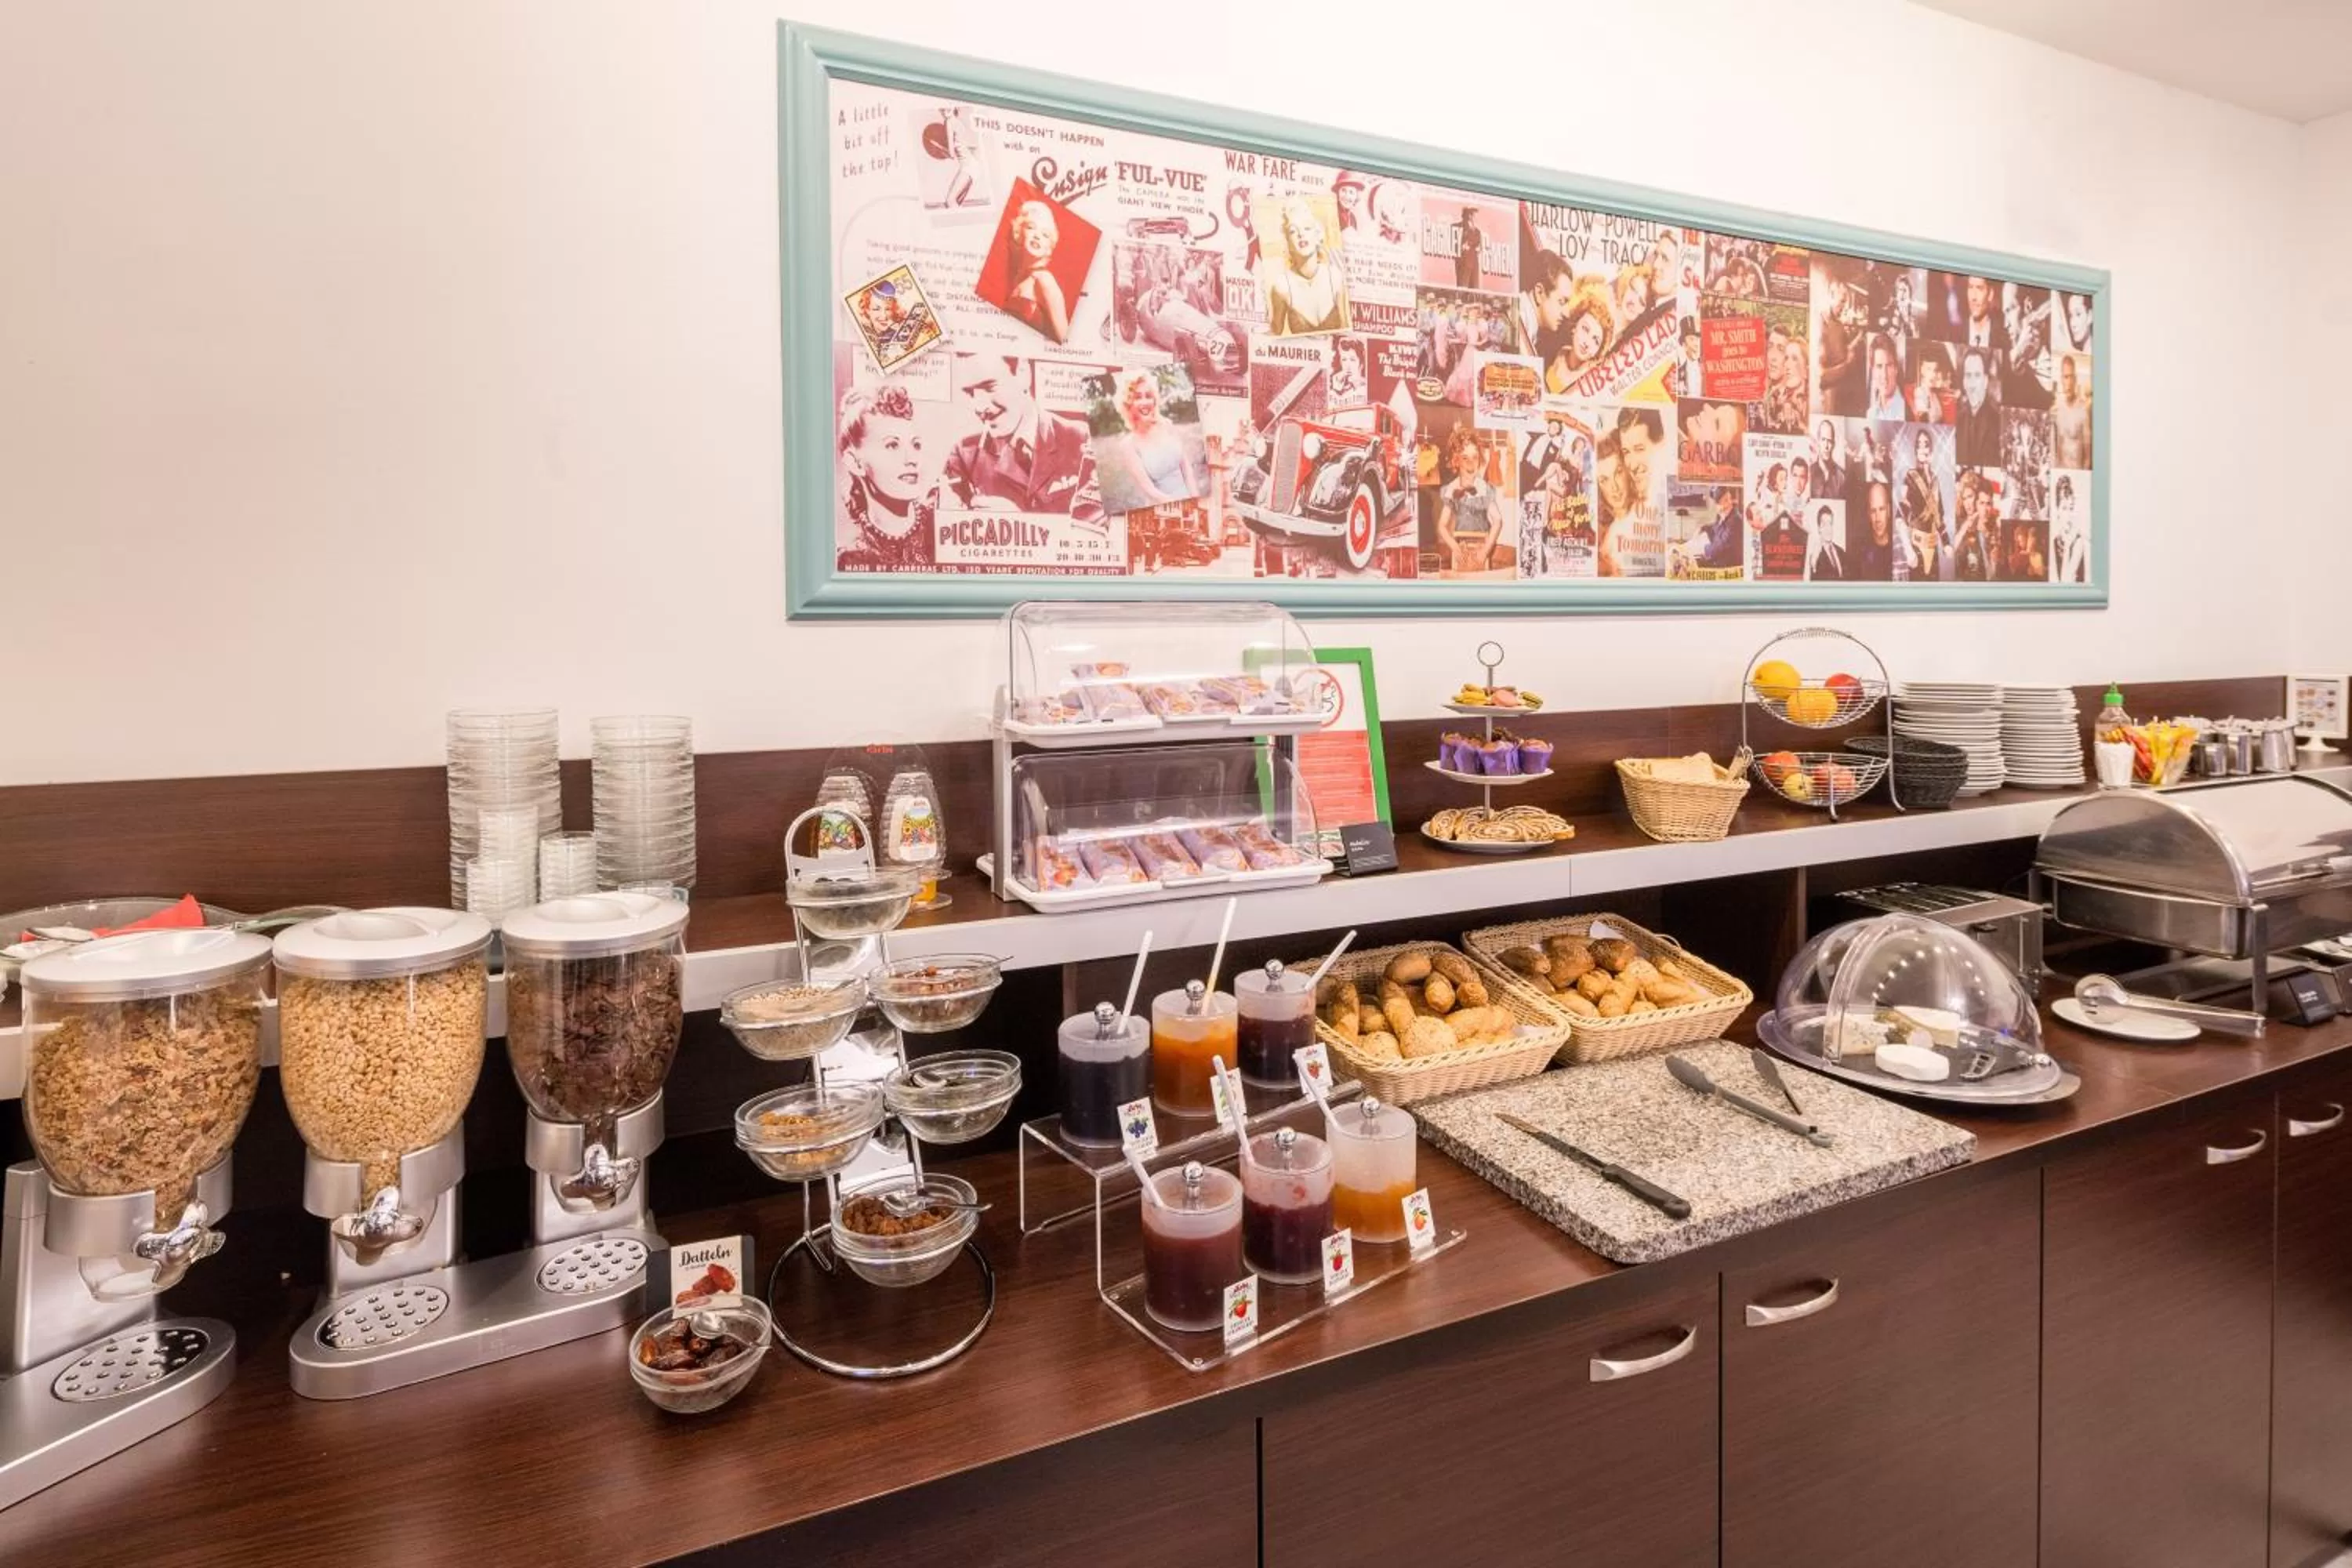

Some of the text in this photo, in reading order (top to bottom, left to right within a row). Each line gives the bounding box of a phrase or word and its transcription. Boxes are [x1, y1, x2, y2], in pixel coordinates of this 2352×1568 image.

[837, 103, 889, 126] A little
[844, 130, 863, 150] bit
[975, 117, 1105, 147] THIS DOESN'T HAPPEN
[1004, 141, 1024, 151] with
[842, 150, 898, 178] the top!
[1225, 150, 1255, 175] WAR
[1264, 156, 1297, 182] FARE
[1031, 156, 1108, 198] Ensign
[1117, 196, 1144, 208] GIANT
[1150, 201, 1171, 210] VIEW
[1530, 201, 1594, 234] HARLOW
[1604, 214, 1660, 243] POWELL
[1559, 233, 1589, 261] LOY
[1600, 239, 1650, 267] TRACY
[1360, 301, 1418, 328] WILLIAMS
[1210, 340, 1225, 356] 27
[1268, 344, 1321, 362] MAURIER
[1576, 337, 1645, 397] LIBELED
[1705, 357, 1764, 374] WASHINGTON
[1679, 441, 1740, 464] GARBO
[938, 517, 1051, 547] PICCADILLY
[960, 549, 1034, 558] CIGARETTES
[844, 563, 870, 572] MADE
[876, 564, 887, 572] BY
[891, 564, 937, 573] CARRERAS
[679, 1244, 733, 1268] Datteln
